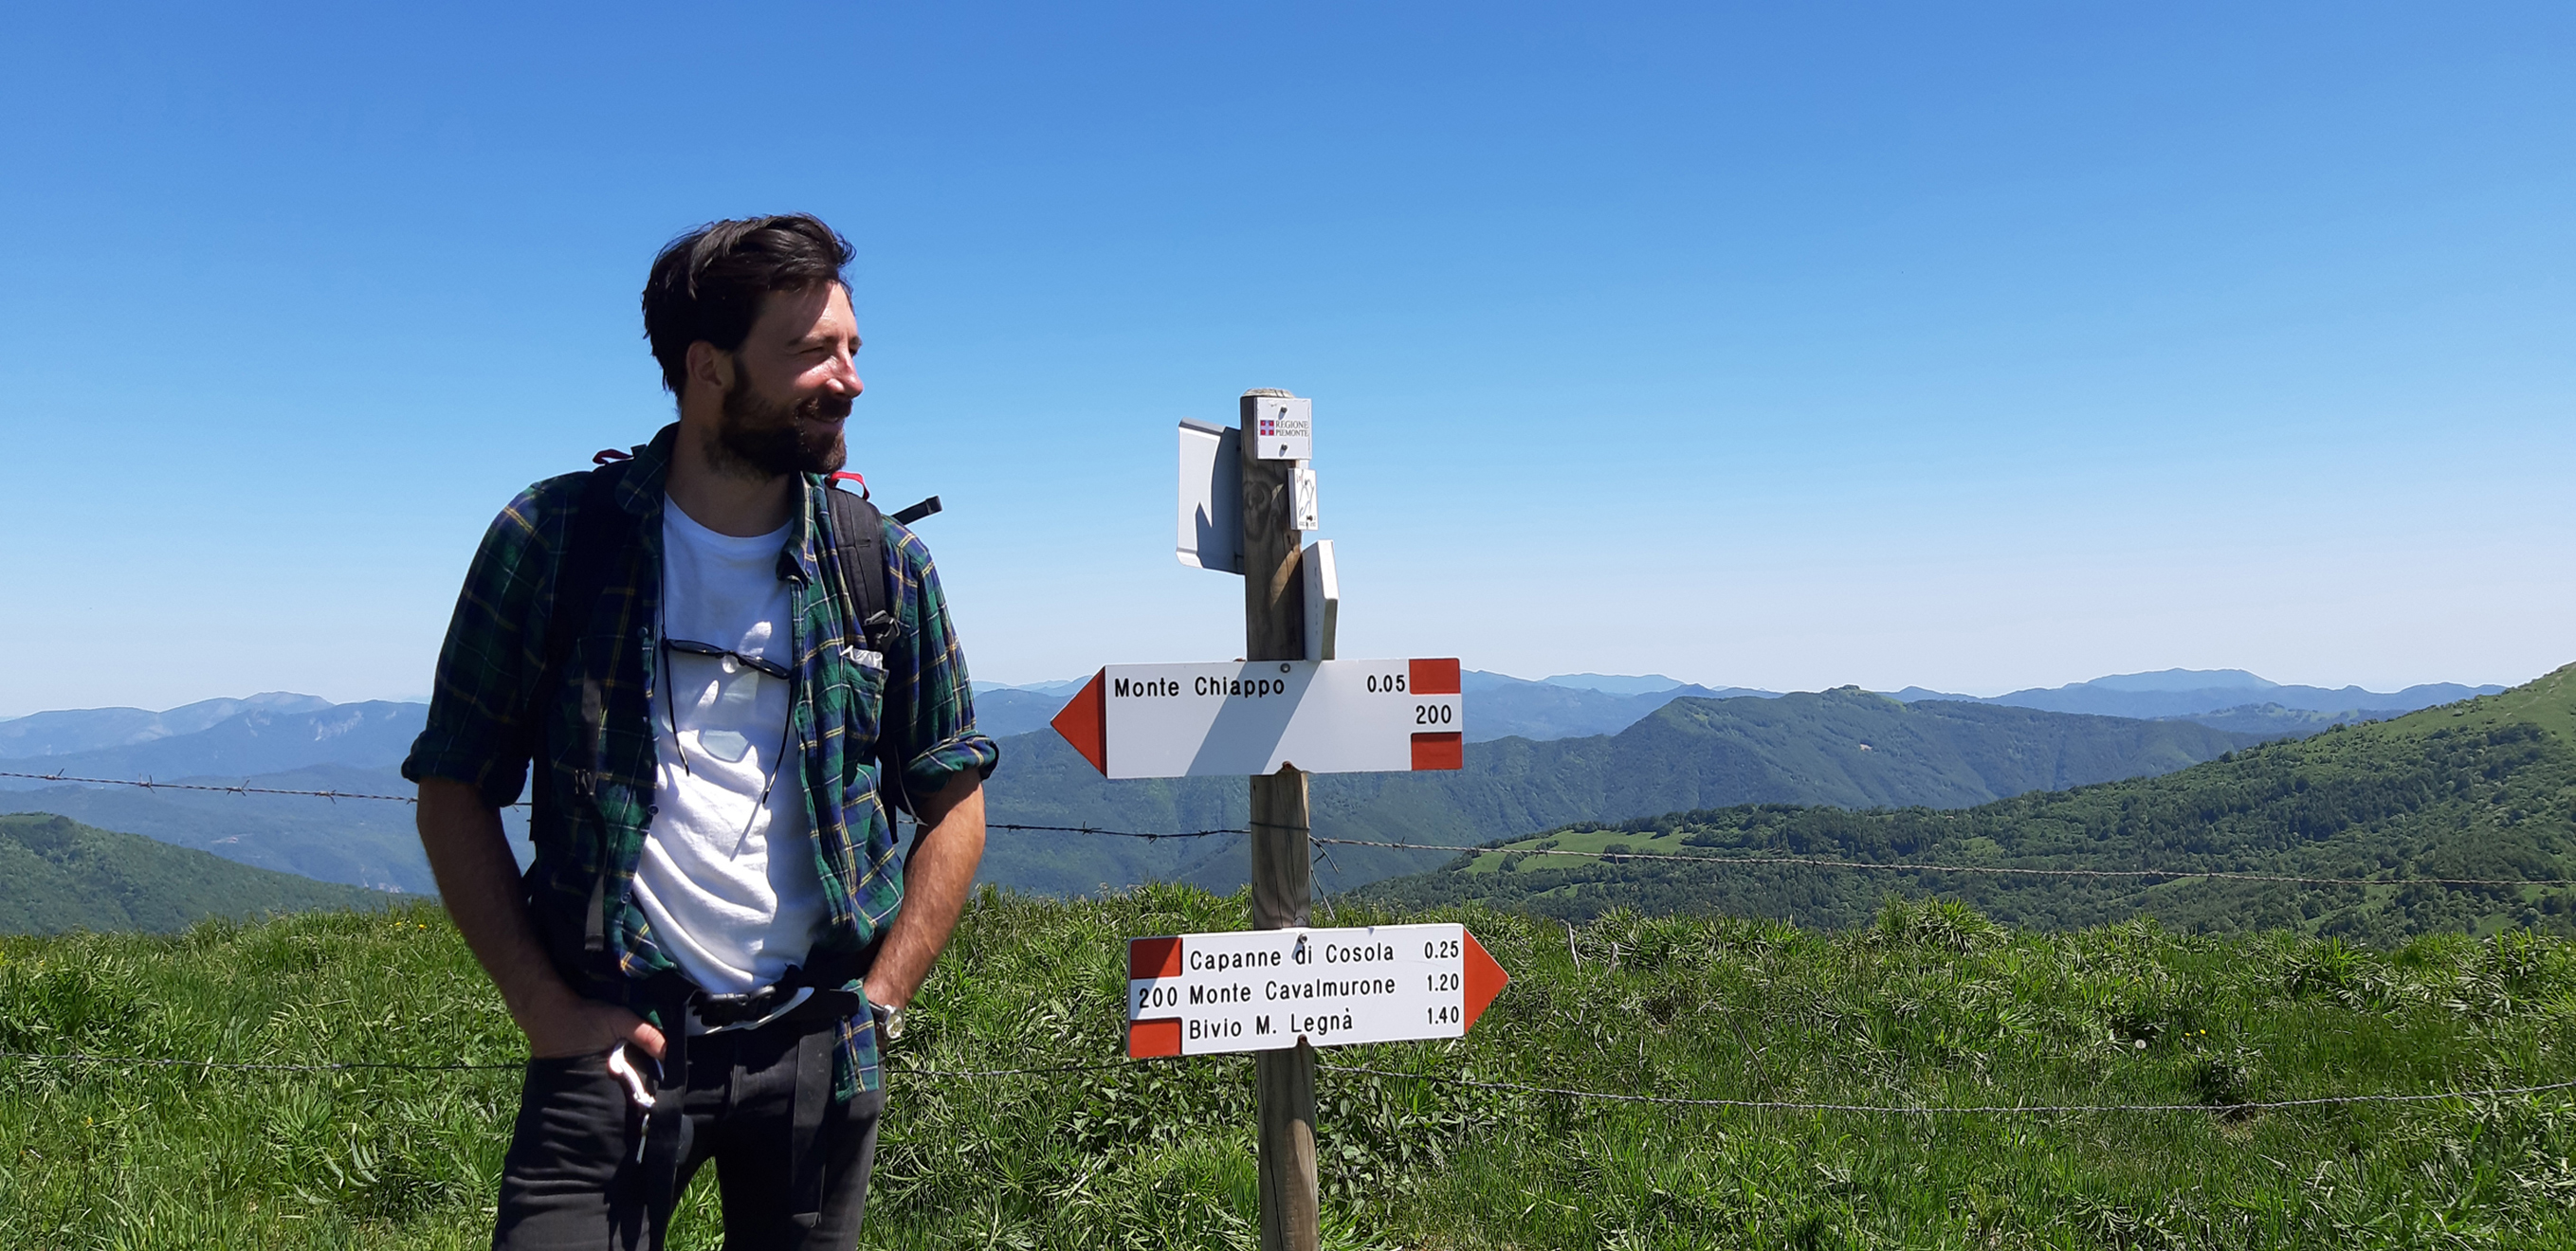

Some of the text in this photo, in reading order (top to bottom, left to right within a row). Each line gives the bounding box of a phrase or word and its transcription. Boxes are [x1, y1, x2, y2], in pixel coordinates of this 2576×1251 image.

[1275, 420, 1309, 428] REGIONE
[1114, 674, 1406, 698] Monte Chiappo 0.05
[1416, 704, 1452, 725] 200
[1190, 940, 1459, 972] Capanne di Cosola 0.25
[1139, 987, 1178, 1009] 200
[1189, 973, 1459, 1006] Monte Cavalmurone 1.20
[1189, 1006, 1459, 1041] Bivio M. Legnà 1.40
